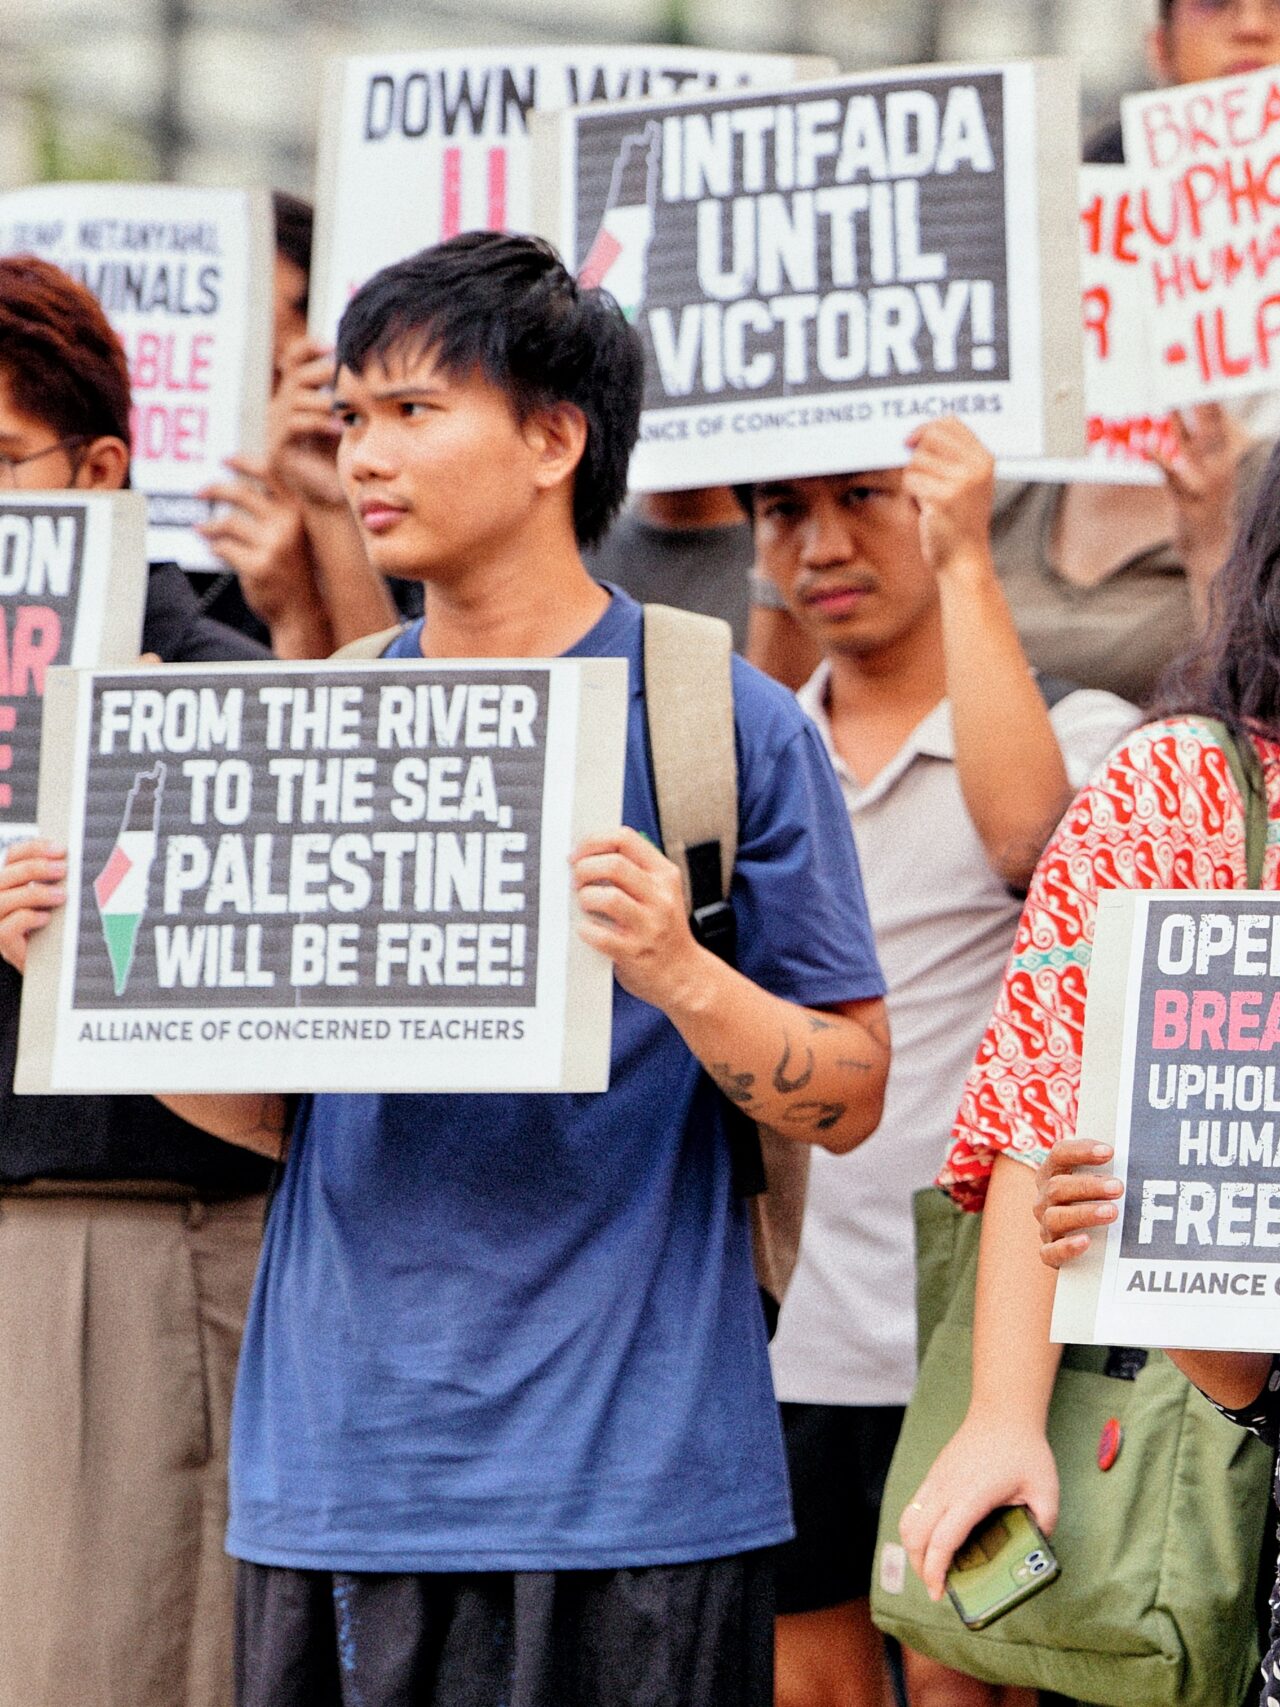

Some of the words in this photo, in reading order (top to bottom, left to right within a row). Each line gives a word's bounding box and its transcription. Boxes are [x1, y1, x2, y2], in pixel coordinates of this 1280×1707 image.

[366, 67, 535, 141] DOWN
[661, 86, 996, 202] INTIFADA
[697, 179, 948, 300] UNTIL
[648, 280, 997, 397] VICTORY!
[698, 413, 726, 437] OF
[731, 404, 874, 434] CONCERNED
[880, 392, 1002, 418] TEACHERS
[99, 688, 243, 755] FROM
[258, 687, 361, 752] THE
[377, 684, 539, 750] RIVER
[182, 758, 252, 826] TO
[269, 757, 376, 826] THE
[391, 755, 512, 829] SEA,
[163, 831, 528, 915] PALESTINE
[154, 924, 275, 989] WILL
[289, 924, 360, 988] BE
[375, 922, 526, 987] FREE!
[78, 1019, 195, 1043] ALLIANCE
[200, 1019, 234, 1042] OF
[238, 1018, 392, 1042] CONCERNED
[399, 1018, 526, 1042] TEACHERS
[1126, 1269, 1270, 1297] ALLIANCE
